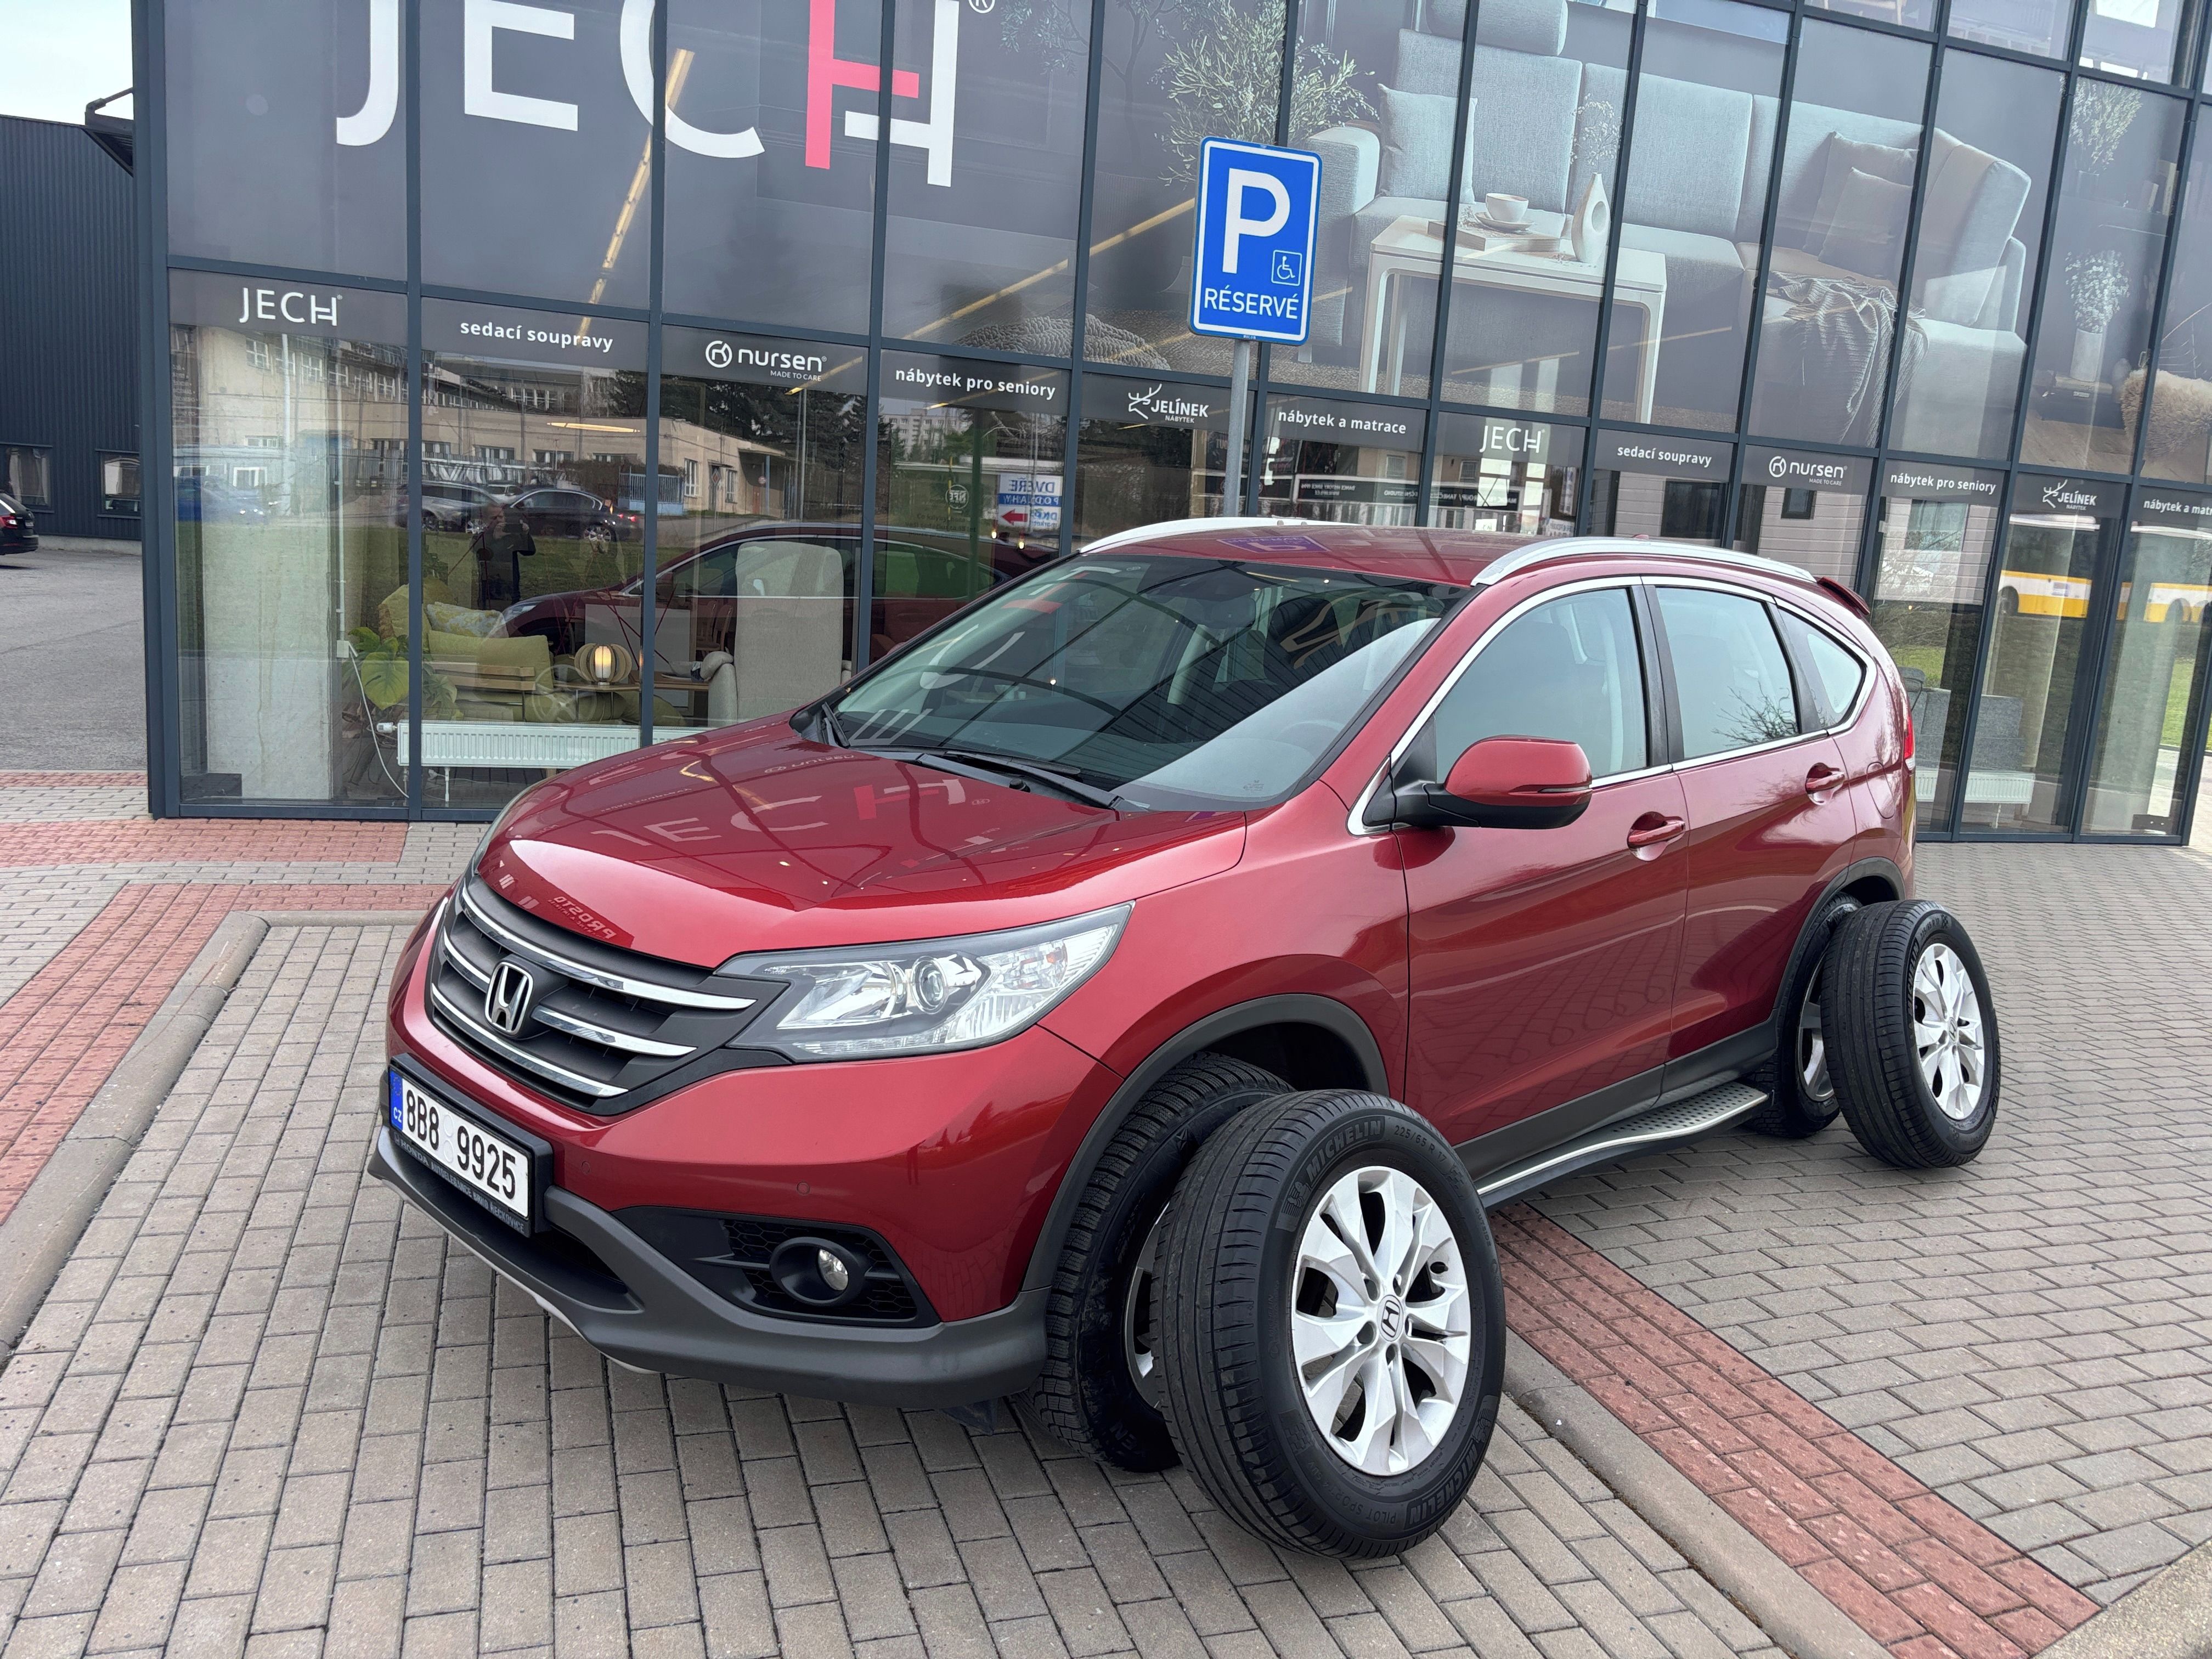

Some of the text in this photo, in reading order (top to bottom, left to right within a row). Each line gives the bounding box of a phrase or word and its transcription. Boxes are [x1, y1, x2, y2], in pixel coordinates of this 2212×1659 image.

[336, 0, 959, 187] JECH
[1222, 167, 1290, 274] P
[239, 287, 337, 326] JECH
[1204, 285, 1299, 319] RÉSERVÉ
[460, 321, 613, 353] sedací soupravy
[738, 348, 822, 372] nursen
[770, 370, 791, 379] MADE
[804, 374, 822, 382] CARE
[895, 368, 1056, 400] nábytek pro seniory
[1150, 398, 1209, 417] JELÍNEK
[1165, 415, 1195, 424] NÁBYTEK
[1278, 410, 1406, 435] nábytek a matrace
[1479, 425, 1542, 453] JECH
[1617, 445, 1712, 468] sedací soupravy
[1789, 462, 1844, 479] nursen
[1891, 472, 1996, 495] nábytek pro seniory
[2057, 490, 2097, 506] JELÍNEK
[2143, 499, 2182, 514] nábytek
[393, 1107, 402, 1124] CZ
[400, 1136, 430, 1166] HONDA
[407, 1089, 516, 1200] 8B8 9925
[1306, 1120, 1448, 1184] MICHELIN 225/65 R 17
[1475, 1207, 1492, 1248] OUTSIDE
[1307, 1460, 1323, 1481] SUV
[1408, 1443, 1480, 1525] MICHELIN
[1329, 1488, 1364, 1516] SPORT
[1365, 1511, 1397, 1525] PILOT
